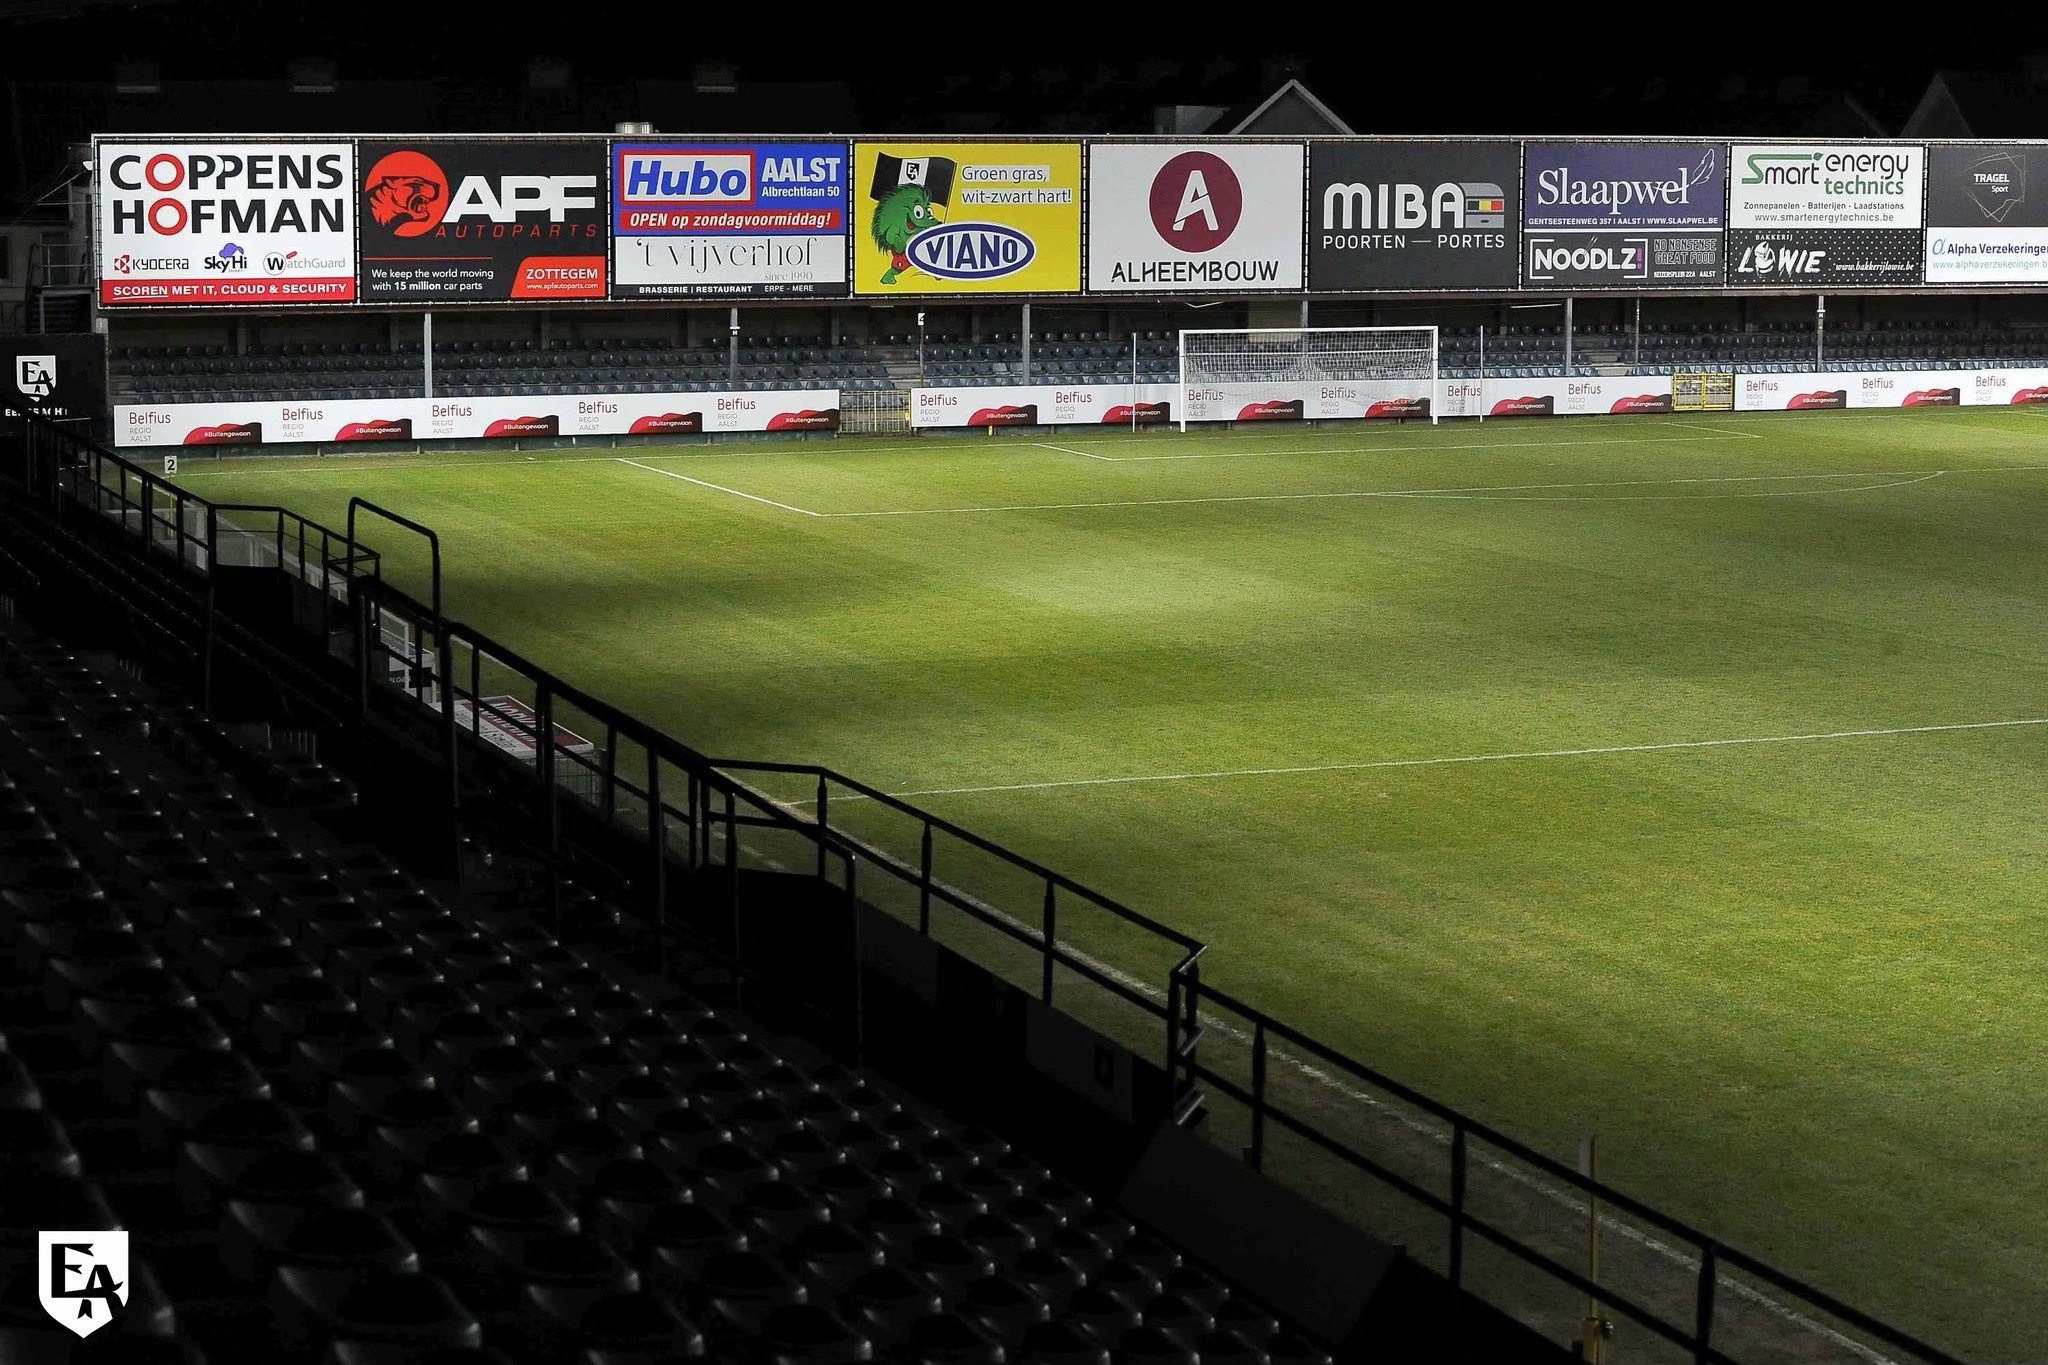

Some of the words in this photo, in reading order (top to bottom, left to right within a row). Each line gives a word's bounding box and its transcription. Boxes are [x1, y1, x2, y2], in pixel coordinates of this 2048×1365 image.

[110, 153, 343, 191] COPPENS
[761, 157, 841, 183] AALST
[1742, 153, 1820, 185] Smart
[1825, 154, 1909, 180] energy
[627, 160, 747, 196] Hubo
[961, 165, 1008, 181] Groen
[1012, 168, 1047, 183] gras,
[1973, 174, 2010, 183] TRAGEL
[761, 186, 825, 197] Albrechtlaan
[826, 186, 840, 197] 50
[1537, 167, 1690, 215] Slaapwel
[1824, 175, 1904, 195] technics
[1991, 185, 2009, 193] Sport
[442, 175, 597, 223] APF
[962, 189, 1032, 203] wit-zwart
[1037, 189, 1072, 203] hart!
[1323, 182, 1464, 230] MIBA
[1744, 202, 1800, 210] Zonnepanelen
[1807, 202, 1847, 211] Batterijen
[1854, 202, 1905, 210] Laadstations
[113, 197, 344, 235] HOFMAN
[630, 213, 667, 227] OPEN
[671, 215, 690, 229] op
[693, 212, 832, 229] zondagvoormiddag!
[1755, 213, 1894, 223] www.smartenergytechnics.be
[436, 224, 597, 238] AUTOPARTS
[1323, 235, 1406, 249] POORTEN
[1437, 234, 1505, 249] PORTES
[1653, 238, 1668, 251] NO
[1668, 238, 1717, 251] NONSENSE
[668, 237, 818, 274] vijverhof
[925, 233, 1018, 269] VIANO
[1947, 244, 1977, 256] Alpha
[265, 255, 346, 272] WatchGuard
[1535, 248, 1643, 270] NOODLZ!
[1655, 251, 1689, 265] GREAT
[1690, 251, 1716, 265] FOOD
[1111, 260, 1279, 283] ALHEEMBOUW
[1835, 261, 1915, 274] www.bakkerijlowie.be
[371, 269, 388, 278] We
[389, 269, 412, 280] keep
[415, 269, 429, 278] the
[431, 269, 458, 278] world
[459, 269, 494, 280] moving
[526, 269, 598, 280] ZOTTEGEM
[764, 271, 789, 281] since
[790, 272, 814, 281] 1990
[113, 285, 168, 296] SCOREN
[171, 285, 199, 295] MET
[202, 285, 217, 296] IT,
[221, 284, 266, 294] CLOUD
[269, 284, 278, 294] &
[282, 283, 347, 294] SECURITY
[372, 282, 391, 291] with
[394, 282, 407, 291] 15
[409, 282, 441, 291] million
[443, 283, 458, 291] car
[459, 282, 483, 292] parts
[526, 282, 599, 290] www.apfautoparts.com
[639, 286, 689, 294] BRASSERIE
[696, 285, 753, 293] RESTAURANT
[792, 284, 814, 292] MERE
[1746, 380, 1779, 391] Belfius
[1862, 378, 1894, 389] Belfius
[1975, 376, 2006, 387] Belfius
[1188, 389, 1224, 401] Belfius
[1321, 387, 1356, 399] Belfius
[1447, 385, 1481, 397] Belfius
[1568, 383, 1602, 395] Belfius
[717, 398, 756, 410] Belfius
[920, 394, 957, 406] Belfius
[1055, 391, 1092, 404] Belfius
[432, 404, 472, 417] Belfius
[578, 401, 618, 414] Belfius
[130, 412, 171, 425] Belfius
[282, 408, 323, 421] Belfius
[503, 423, 549, 431] #Buitengewoon
[648, 420, 693, 428] #Buitengewoon
[167, 459, 175, 470] 2
